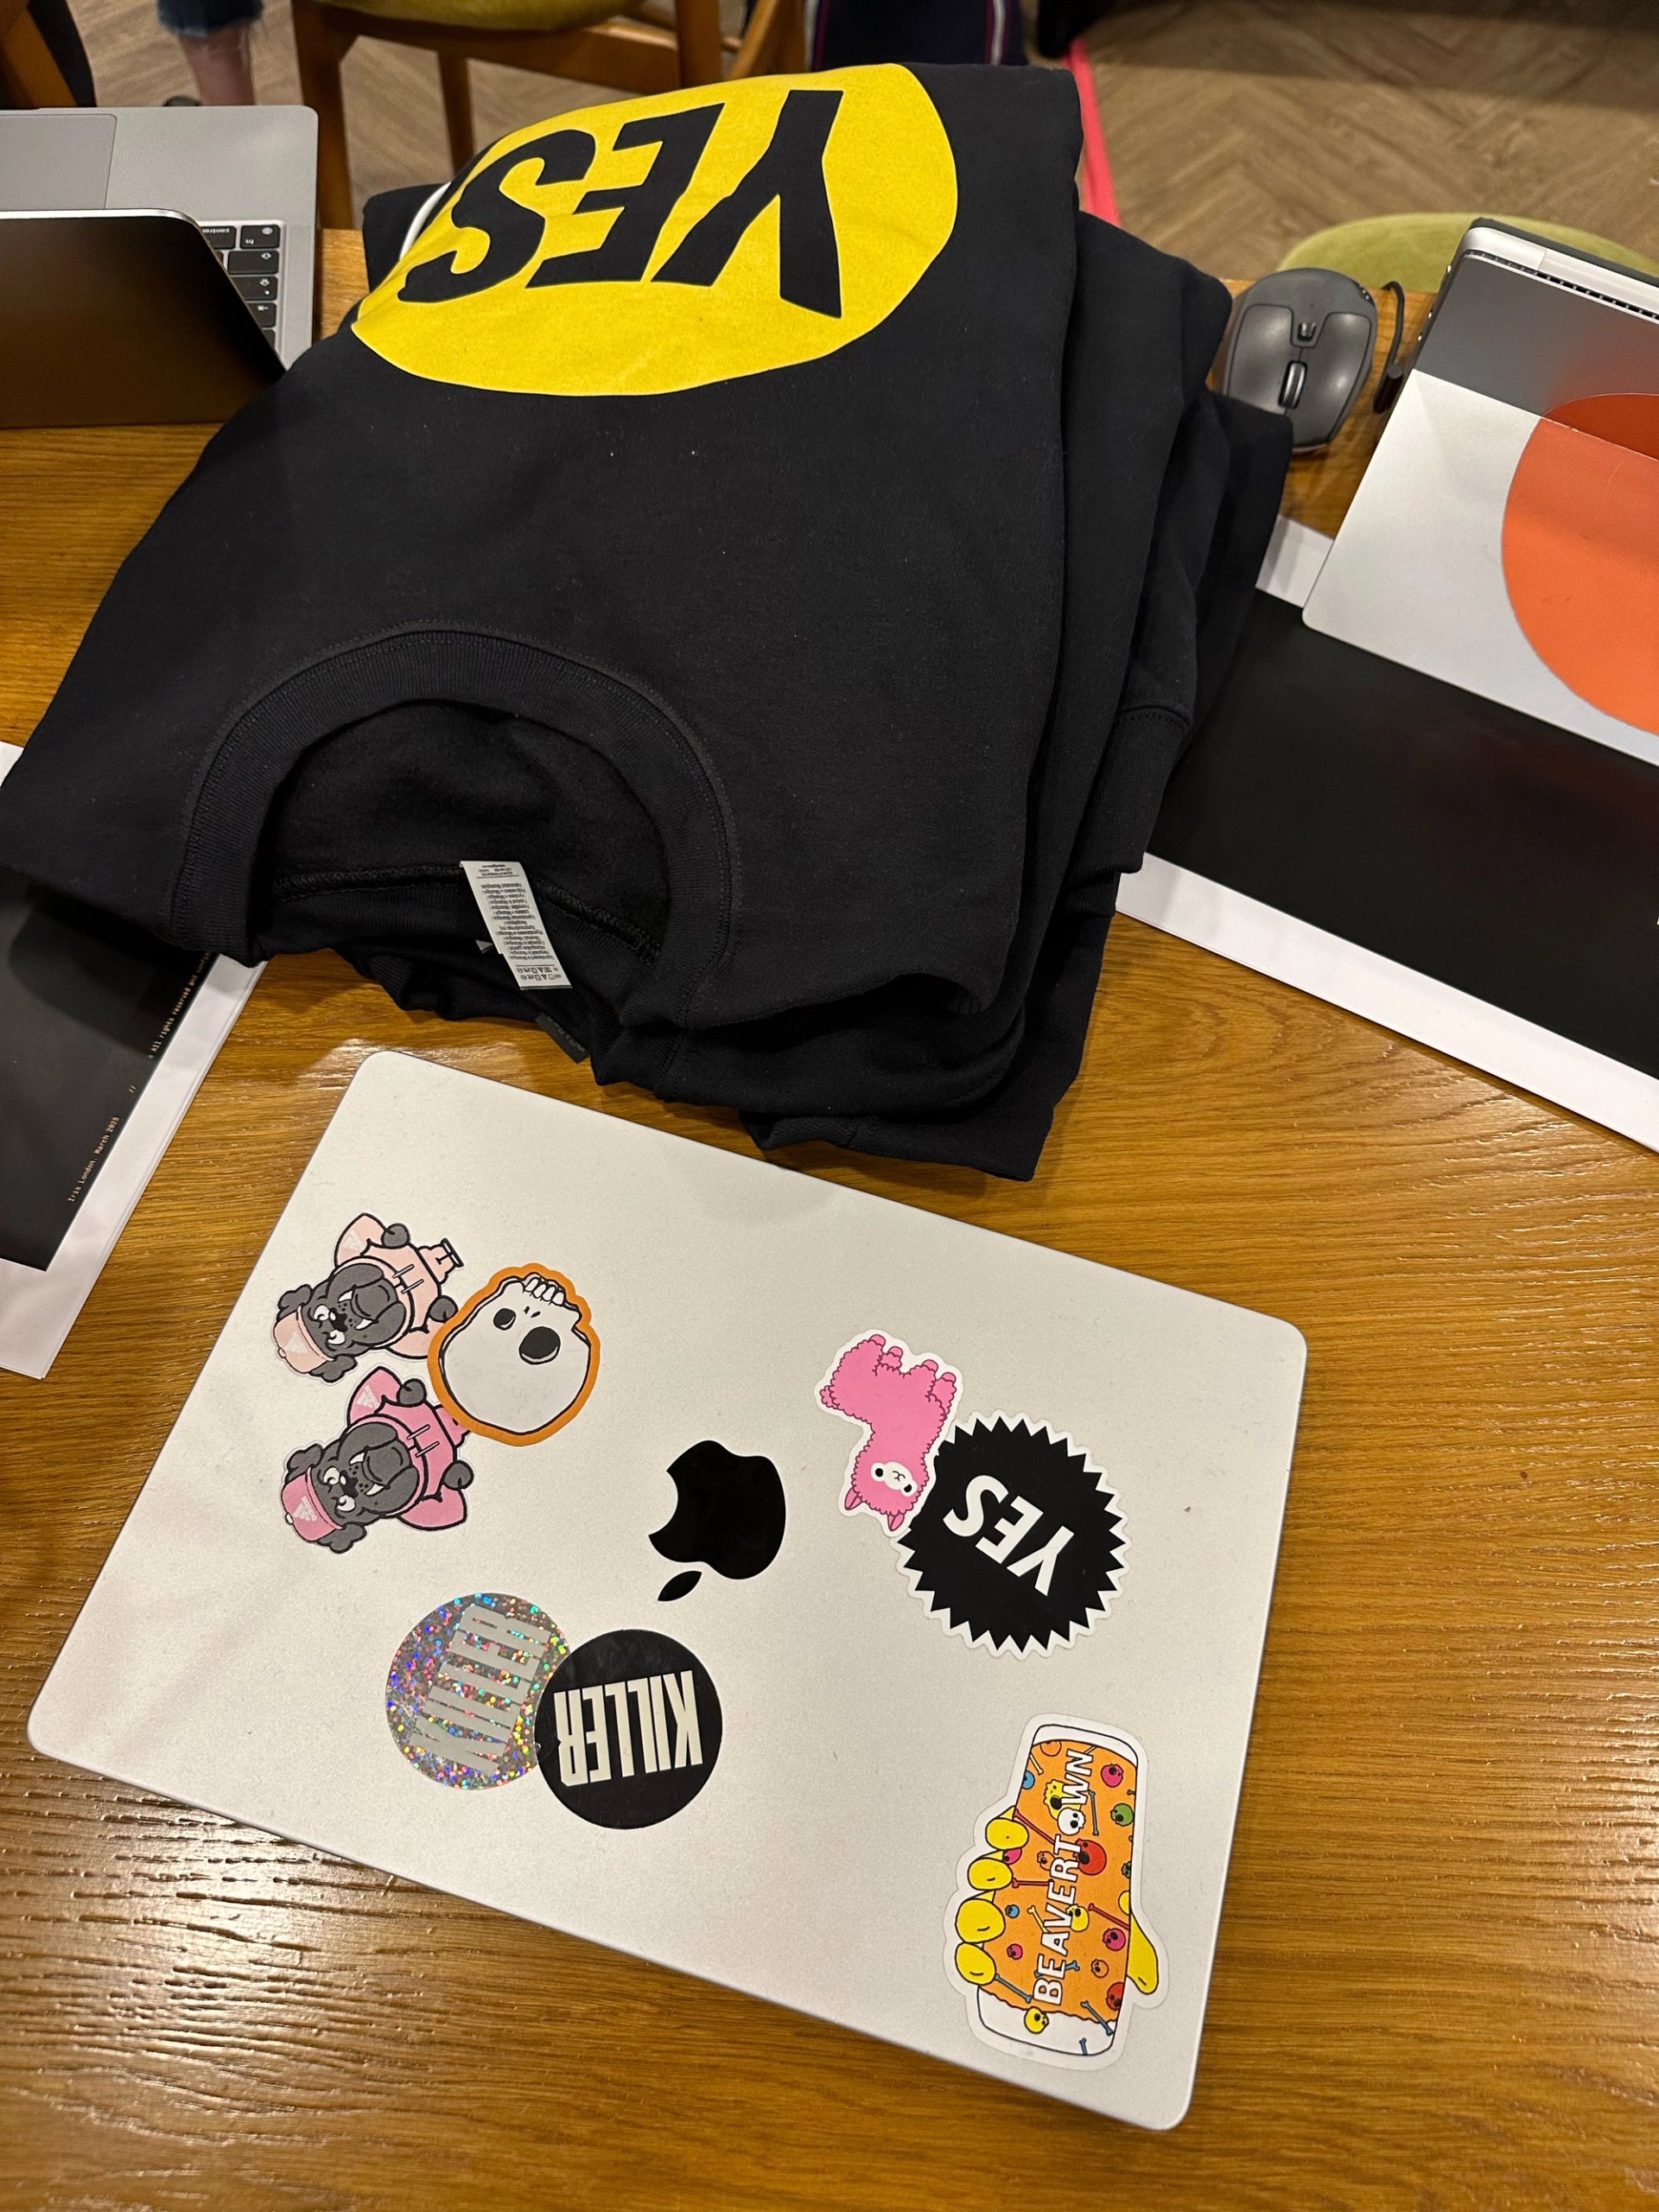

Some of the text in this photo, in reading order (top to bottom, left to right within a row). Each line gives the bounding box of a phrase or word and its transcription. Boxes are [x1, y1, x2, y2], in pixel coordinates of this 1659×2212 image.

[398, 90, 843, 318] YES
[68, 1185, 80, 1203] Iris
[93, 1135, 110, 1154] March
[106, 1116, 119, 1132] 2025
[151, 1040, 162, 1052] All
[159, 1017, 175, 1039] rights
[172, 988, 191, 1014] reserved
[188, 975, 198, 986] and
[943, 1475, 1074, 1596] YES
[409, 1604, 551, 1774] KILLER
[554, 1670, 702, 1787] KILLER
